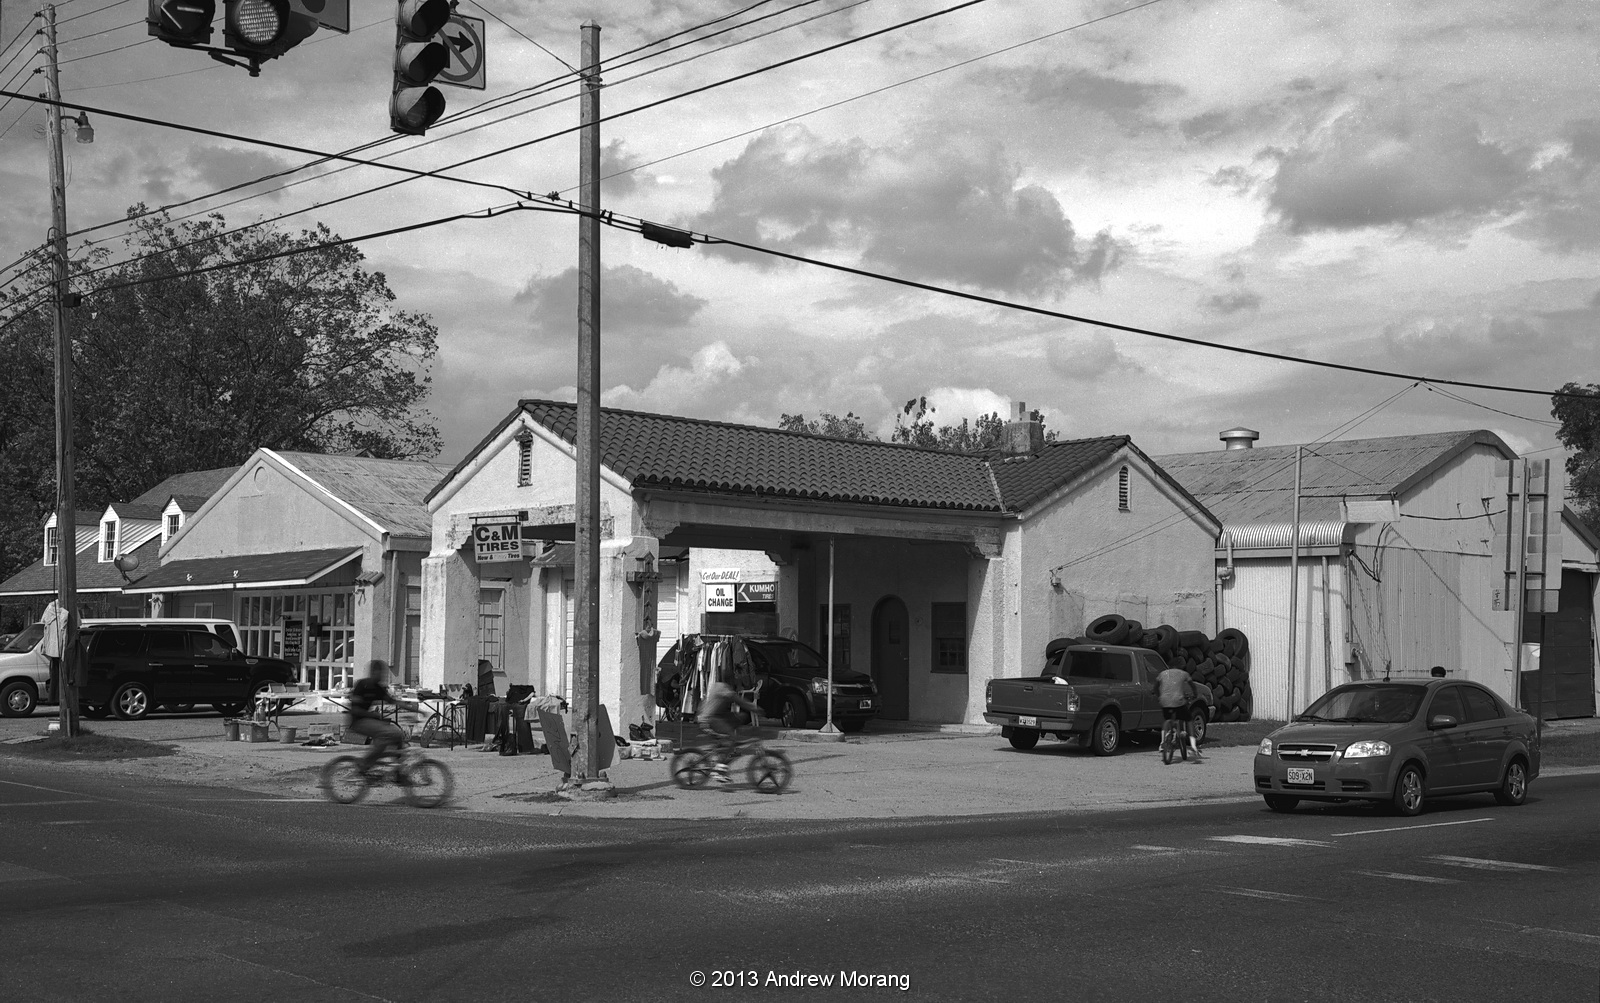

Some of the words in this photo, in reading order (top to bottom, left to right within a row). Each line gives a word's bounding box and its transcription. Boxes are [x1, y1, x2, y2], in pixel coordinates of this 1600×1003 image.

[477, 541, 519, 552] TIRES
[715, 587, 726, 597] OIL
[749, 584, 775, 593] KUMHO
[707, 597, 734, 607] CHANGE
